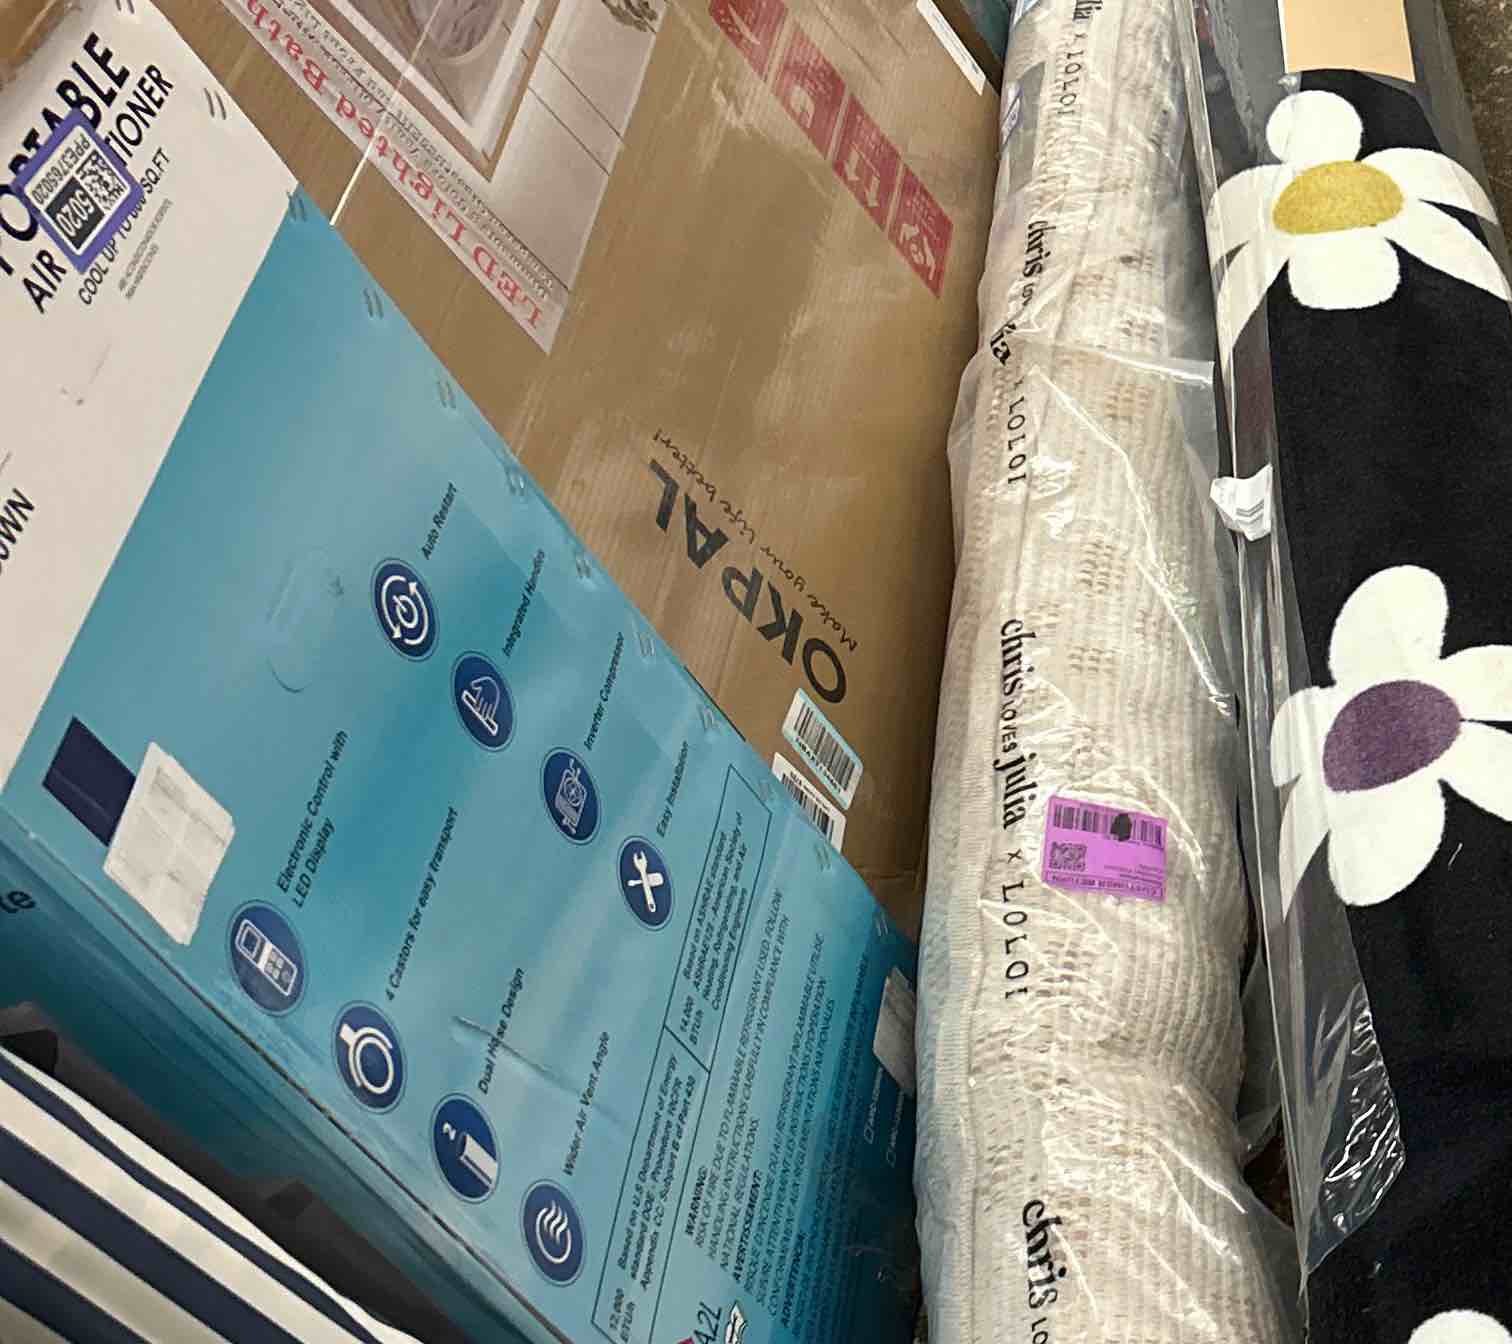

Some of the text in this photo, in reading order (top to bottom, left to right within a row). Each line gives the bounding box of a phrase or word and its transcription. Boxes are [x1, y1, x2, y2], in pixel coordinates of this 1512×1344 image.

[1058, 51, 1084, 114] LOLOI
[332, 94, 463, 243] Lighted
[55, 187, 96, 238] 5020
[1023, 220, 1056, 278] chris
[22, 249, 67, 314] AIR
[78, 265, 109, 305] COOL
[465, 243, 543, 328] LED
[1006, 396, 1028, 486] LOLOI
[421, 482, 457, 560] Auto Restart
[654, 429, 858, 651] Make your life better!
[650, 459, 847, 704] OKPAL
[1001, 618, 1037, 698] chris
[584, 702, 605, 750] Inverter
[1000, 699, 1017, 753] LOVES
[276, 730, 348, 893] Electronic Control with
[656, 807, 674, 838] Easy
[994, 751, 1038, 830] julia
[291, 817, 335, 908] LED Display
[388, 932, 415, 989] Castors
[407, 907, 423, 931] for
[416, 873, 437, 907] easy
[428, 806, 458, 873] transport
[1001, 879, 1030, 1000] LOLOI
[477, 969, 525, 1094] Dual Hose Design
[1022, 1199, 1068, 1309] chris
